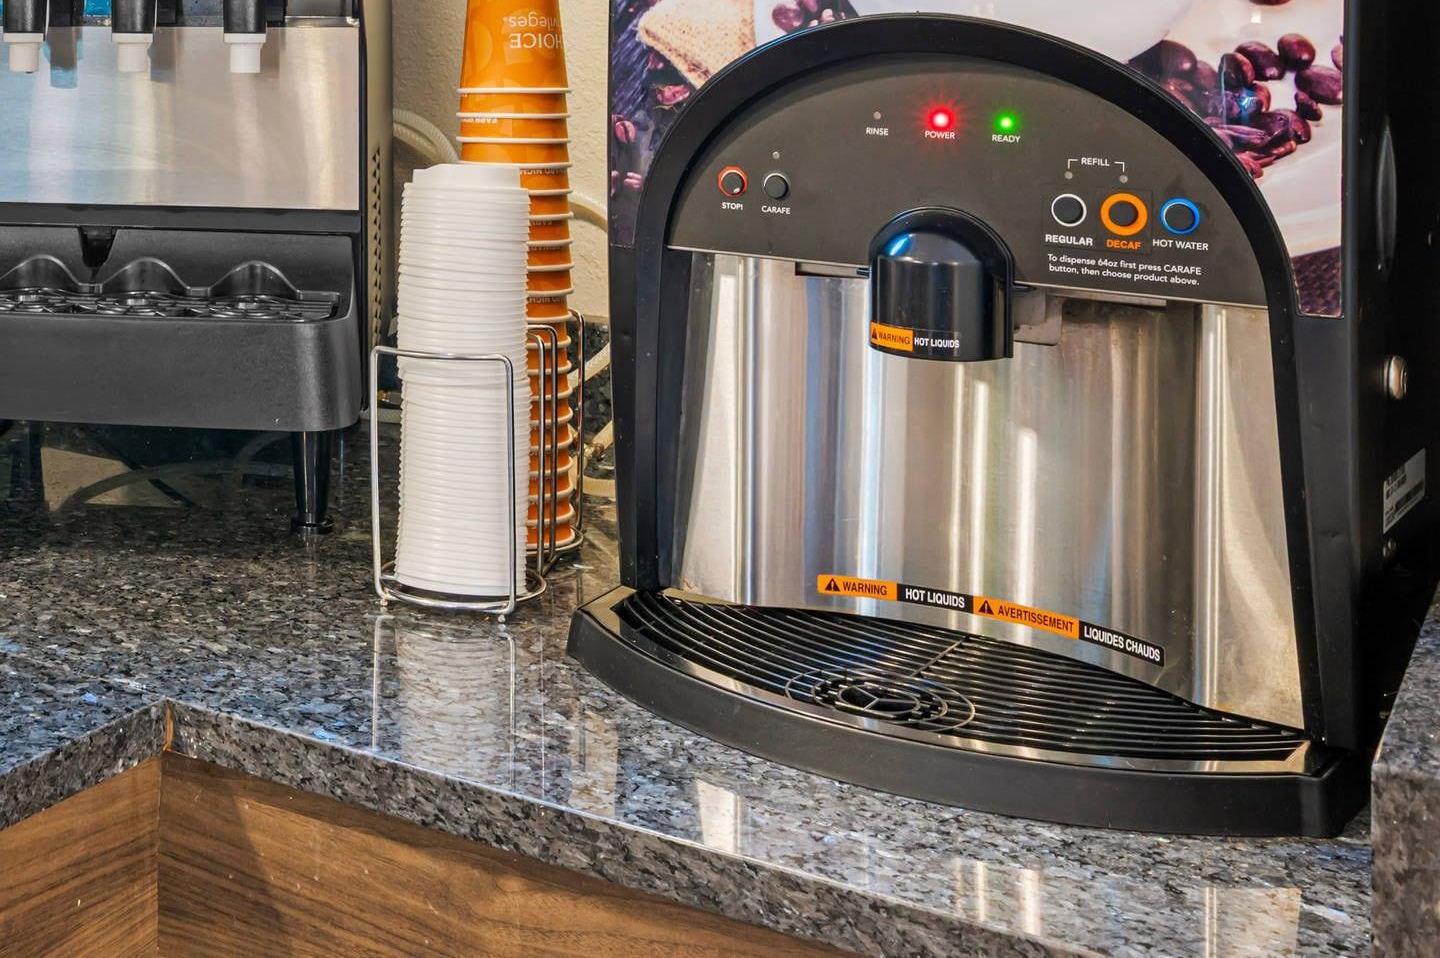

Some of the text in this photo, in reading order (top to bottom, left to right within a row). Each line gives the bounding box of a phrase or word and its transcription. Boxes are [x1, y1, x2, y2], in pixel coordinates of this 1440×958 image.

[865, 127, 889, 136] RINSE
[924, 130, 956, 139] POWER
[992, 134, 1021, 143] READY
[1081, 157, 1110, 167] REFILL
[761, 205, 791, 215] CARAFE
[1045, 234, 1093, 246] REGULAR
[1106, 239, 1141, 250] DECAF
[1152, 239, 1209, 251] HOT WATER
[1048, 253, 1202, 276] To dispense 64oz first press CARAFE
[1049, 264, 1200, 286] button, then choose product above.
[878, 332, 960, 348] WARNING HOT LIQUIDS
[842, 581, 965, 609] WARNING HOT LIQUIDS
[998, 605, 1161, 662] AVERTISSEMENT LIQUIDES CHAUDS
